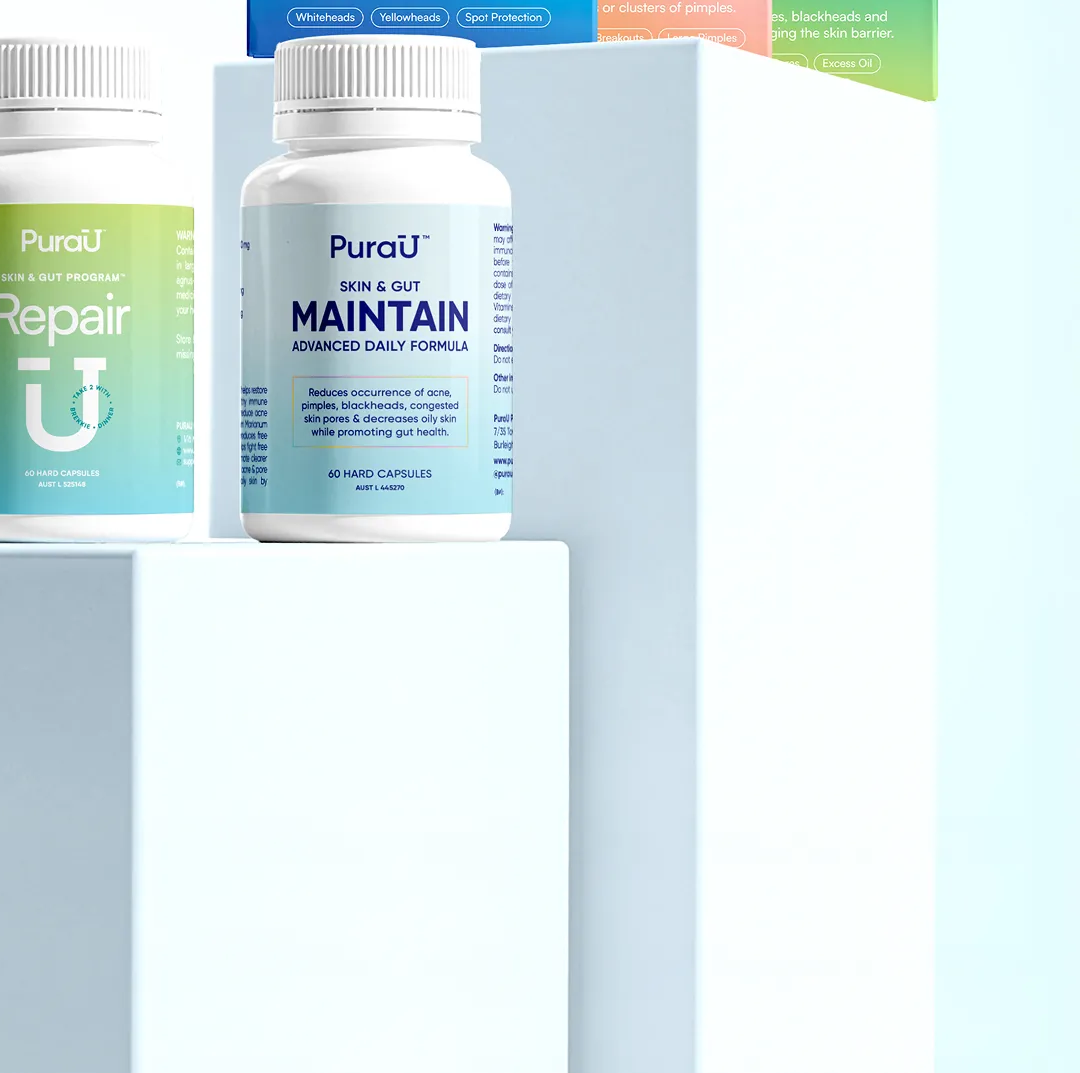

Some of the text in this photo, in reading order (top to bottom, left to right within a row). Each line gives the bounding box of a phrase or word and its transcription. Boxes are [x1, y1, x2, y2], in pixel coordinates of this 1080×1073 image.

[602, 4, 616, 14] or
[618, 1, 667, 14] clusters
[668, 1, 682, 14] of
[684, 1, 736, 16] pimples.
[294, 12, 357, 23] Whiteheads
[379, 12, 442, 23] Yellowheads
[464, 12, 543, 25] Spot Protection
[791, 10, 862, 23] blackheads
[864, 10, 888, 23] and
[799, 26, 895, 39] the skin barrier.
[822, 57, 873, 69] Excess Oil
[0, 272, 25, 283] SKIN
[27, 272, 36, 282] &
[38, 272, 63, 282] GUT
[339, 280, 421, 293] SKIN & GUT
[293, 301, 468, 332] MAINTAIN
[291, 340, 469, 352] ADVANCED DAILY FORMULA
[308, 387, 452, 398] Reduces occurrence of acne,
[301, 400, 459, 413] pimples, blackheads, congested
[303, 413, 457, 426] skin pores & decreases oily skin
[311, 426, 450, 439] while promoting gut health.
[24, 469, 100, 477] 60 HARD CAPSULES
[327, 469, 433, 479] 60 HARD CAPSULES
[37, 480, 57, 488] AUST
